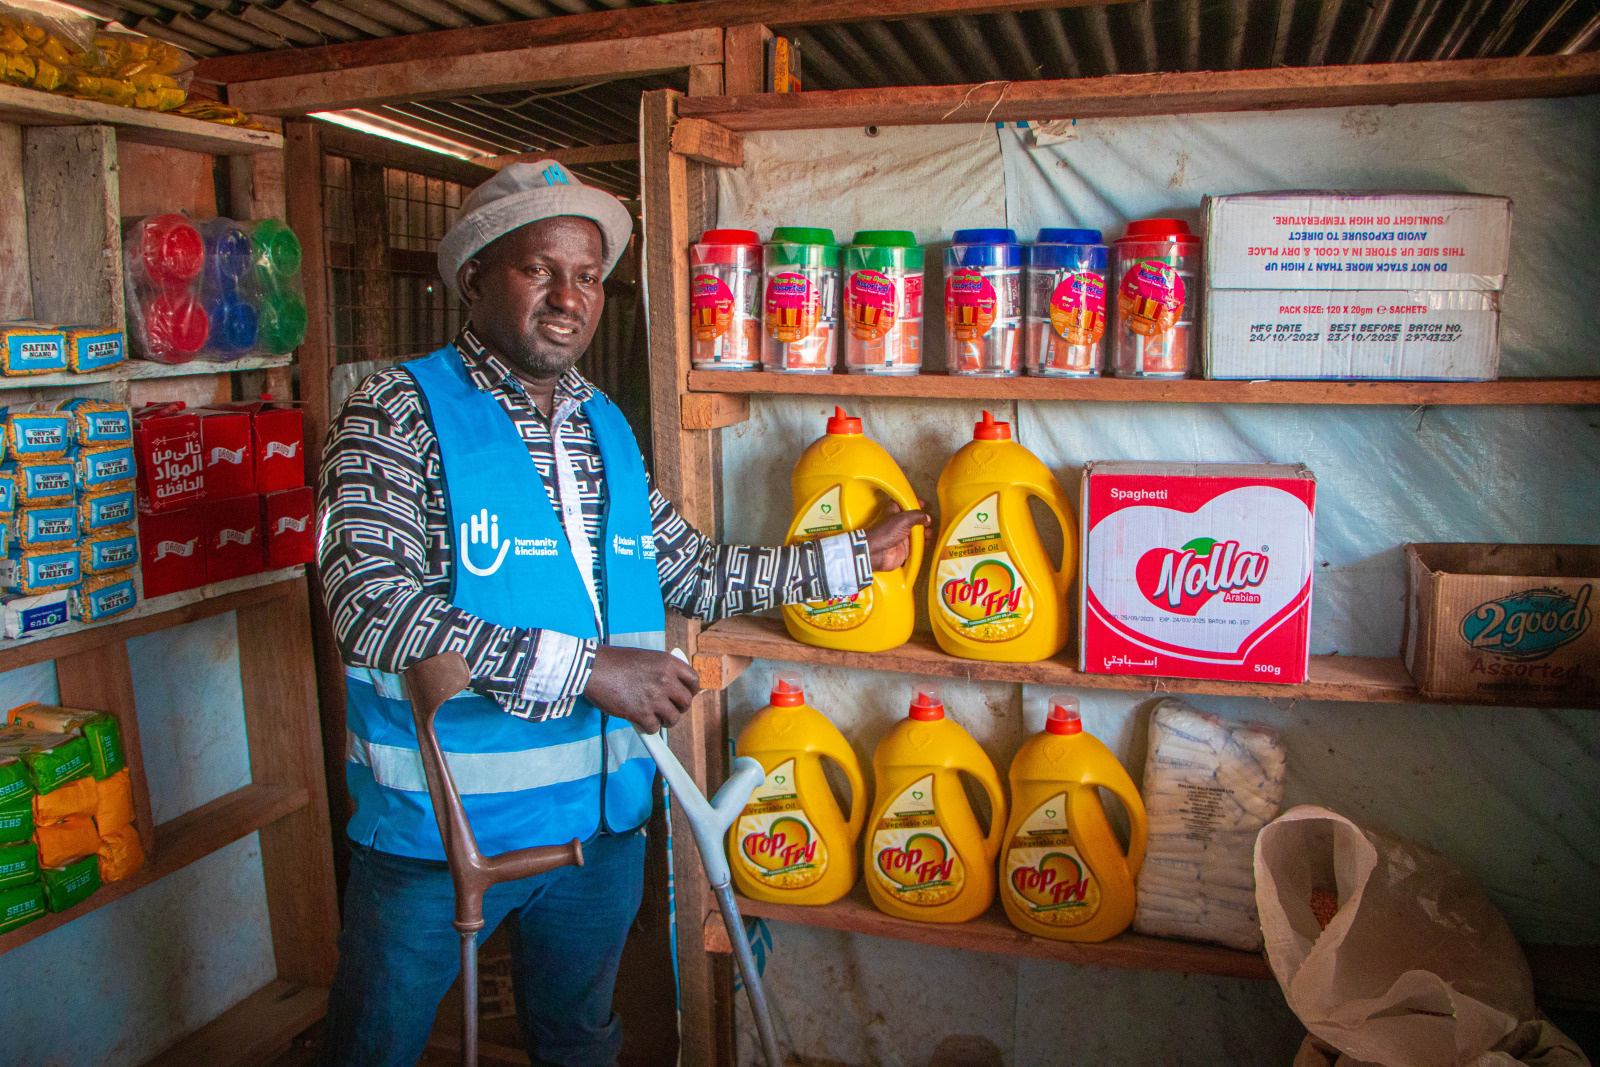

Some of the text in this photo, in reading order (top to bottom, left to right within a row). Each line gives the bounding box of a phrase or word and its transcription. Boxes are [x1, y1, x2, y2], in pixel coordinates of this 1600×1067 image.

[1272, 216, 1445, 226] SUNLIGHT OR HIGH TEMPERATURE.
[1288, 231, 1428, 241] AVOID EXPOSURE TO DIRECT
[1247, 247, 1279, 257] PLACE
[1280, 247, 1301, 257] DRY
[1302, 247, 1311, 257] &
[1313, 247, 1340, 257] COOL
[1343, 247, 1350, 257] A
[1352, 247, 1363, 257] IN
[1365, 247, 1398, 257] STORE
[1417, 247, 1440, 257] SIDE
[1441, 247, 1466, 257] THIS
[1264, 262, 1448, 272] DO NOT STACK MORE THAN 7 HIGH UP
[1138, 268, 1170, 286] Assort
[773, 283, 806, 292] Assorted
[856, 279, 889, 293] Assorted
[1071, 280, 1104, 296] Asorted
[1279, 305, 1428, 316] PACK SIZE: 120 X 20gm SACHETS
[1250, 324, 1463, 333] MFG DATE BEST BEFORE BATCH NO.
[1249, 333, 1320, 342] 24/10/2023
[1327, 333, 1399, 342] 23/10/2025
[22, 344, 58, 352] SAFINA
[88, 341, 119, 352] SAFINA
[97, 425, 126, 433] SAFINA
[27, 436, 62, 444] SAFINA
[152, 447, 172, 465] من
[97, 465, 129, 476] SAFINA
[154, 454, 203, 482] المواد
[35, 480, 70, 490] SAFINA
[156, 476, 204, 498] الحافظة
[1110, 488, 1169, 501] Spaghetti
[100, 507, 130, 520] SAFINA
[38, 525, 73, 535] SAFINA
[514, 537, 558, 548] humanity
[101, 550, 133, 562] SAFINA
[514, 546, 559, 556] &inclusion
[948, 543, 999, 558] Vegetable Oil
[39, 567, 75, 579] SAFINA
[1153, 541, 1269, 608] Nolla
[944, 577, 989, 608] Top
[1225, 593, 1260, 602] Arabian
[99, 595, 130, 611] SAFINA
[981, 586, 1023, 618] Fry
[30, 613, 62, 628] LOTUS
[1471, 584, 1593, 648] 2good
[984, 627, 989, 635] 5
[1103, 654, 1158, 669] إسباجتي
[1254, 664, 1281, 675] 500g
[1469, 657, 1582, 680] Assorted
[55, 756, 81, 776] SHIBE
[749, 802, 796, 814] Vegetable Oil
[885, 820, 920, 829] Vegetable
[745, 831, 786, 858] Top
[1018, 838, 1067, 847] Vegetable Oil
[780, 840, 817, 867] Fry
[880, 847, 923, 874] Top
[915, 857, 954, 884] Fry
[1014, 866, 1057, 894] Top
[1049, 878, 1089, 905] Fry
[7, 899, 36, 916] SHIBE
